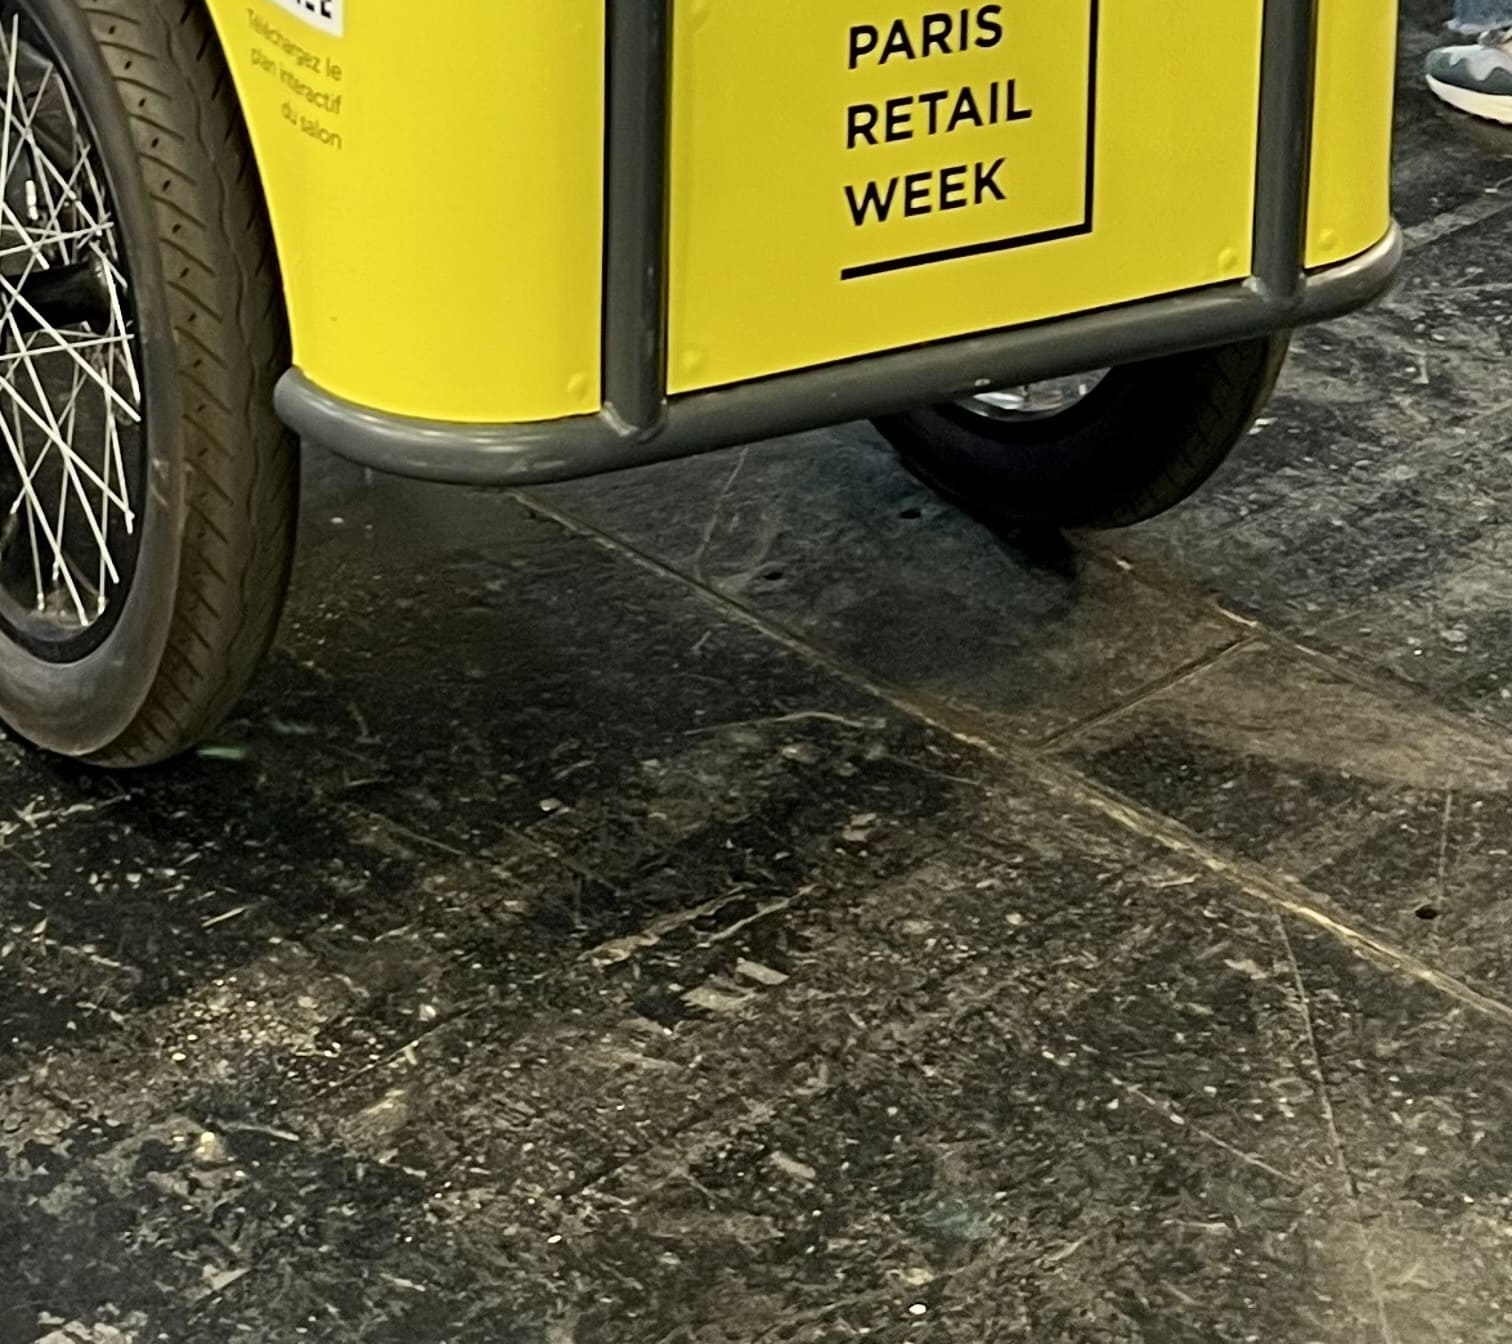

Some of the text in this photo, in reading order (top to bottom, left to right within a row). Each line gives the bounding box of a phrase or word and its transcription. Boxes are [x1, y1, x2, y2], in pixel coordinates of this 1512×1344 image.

[326, 56, 342, 82] le
[847, 4, 1004, 70] PARIS
[282, 101, 342, 150] du salon
[846, 78, 1032, 149] RETAIL
[845, 157, 1007, 227] WEEK
